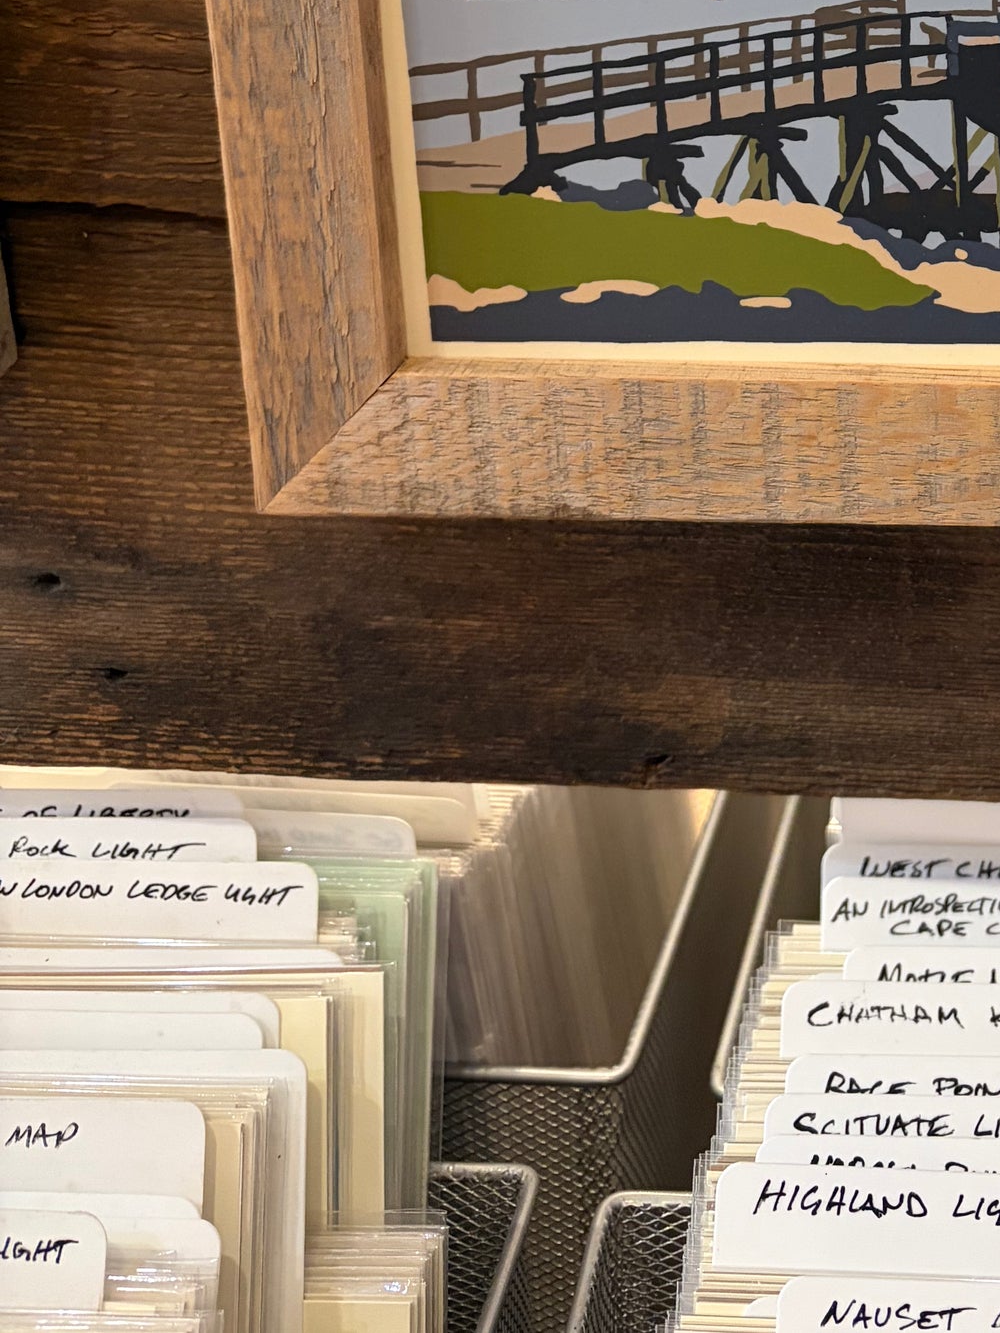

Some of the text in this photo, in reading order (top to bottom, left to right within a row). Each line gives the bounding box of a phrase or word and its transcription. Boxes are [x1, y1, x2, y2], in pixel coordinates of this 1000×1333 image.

[91, 841, 206, 860] LIGHT
[860, 856, 948, 879] WEST
[20, 878, 114, 900] LONDON
[126, 880, 217, 902] LEDGE
[831, 897, 869, 923] AN
[889, 920, 969, 938] CAPE
[807, 1001, 964, 1029] CHATHAM
[4, 1122, 79, 1149] MAP
[792, 1112, 955, 1137] SCITUATE
[752, 1179, 928, 1219] HIGHLAND
[0, 1236, 79, 1264] IGHT
[820, 1299, 977, 1331] NAUSET
